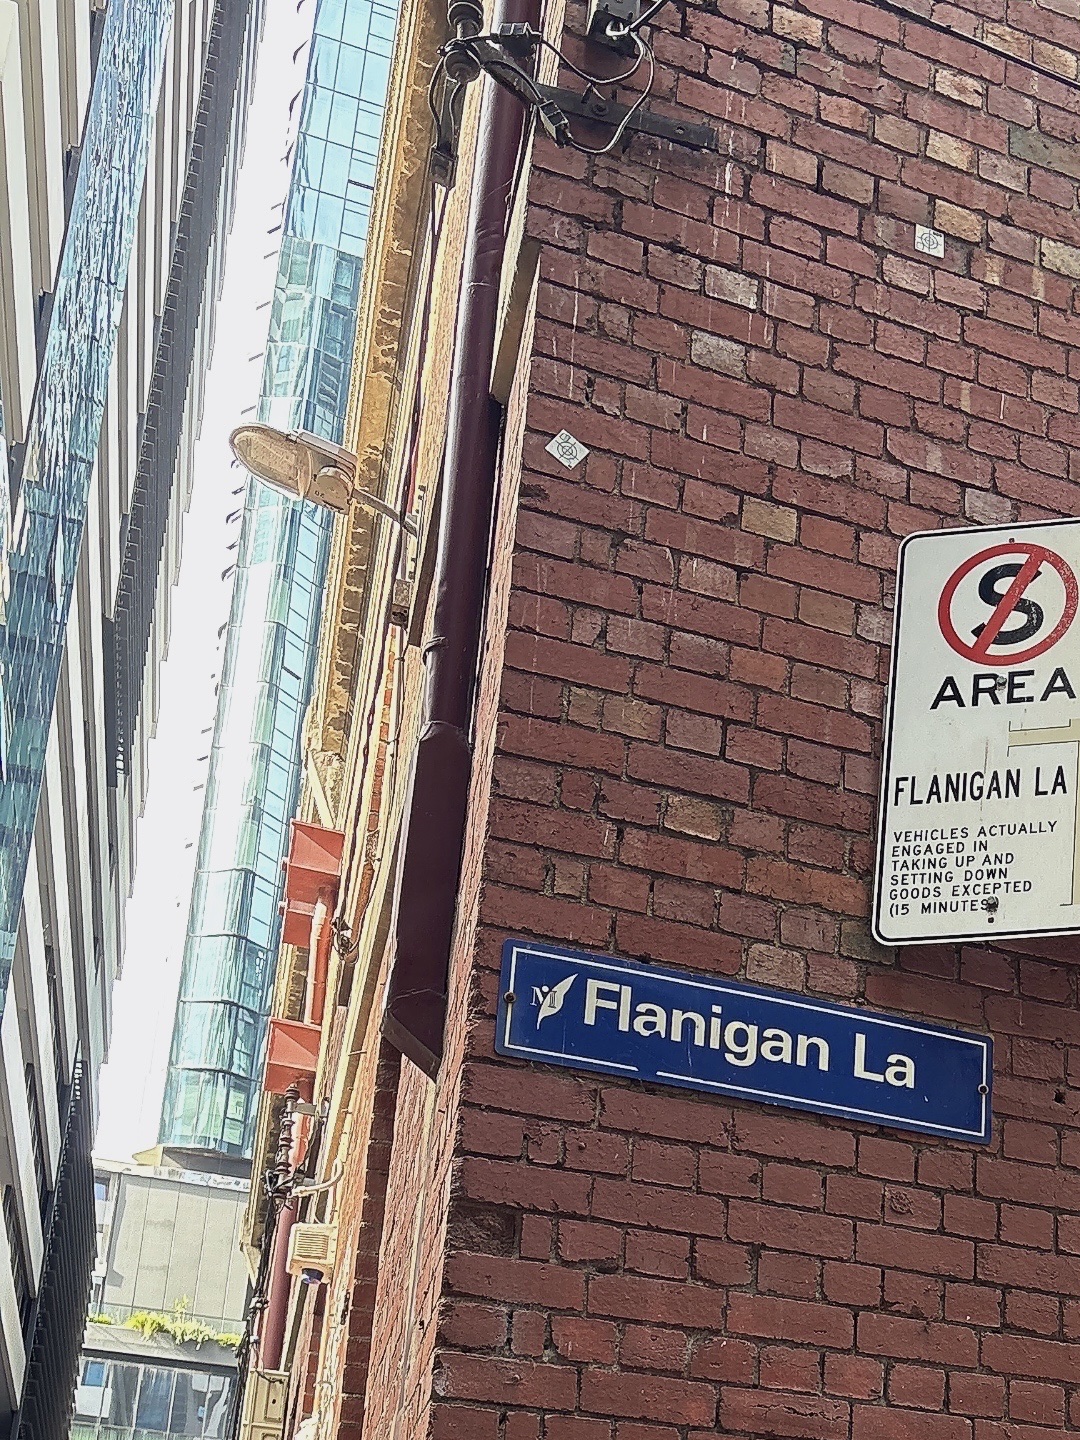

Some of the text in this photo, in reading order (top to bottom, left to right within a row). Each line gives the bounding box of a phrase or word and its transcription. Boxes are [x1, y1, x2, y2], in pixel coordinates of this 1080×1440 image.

[930, 667, 1077, 710] AREA
[894, 765, 1067, 806] FLANIGAN LA
[893, 820, 1058, 843] VEHICLES ACTUALLY
[892, 840, 988, 857] ENGAGED IN
[892, 852, 1014, 872] TAKING UP AND
[890, 867, 1008, 886] SETTING DOWN
[889, 880, 1032, 900] GOODS EXCEPTED
[889, 902, 910, 917] (15
[583, 978, 831, 1071] Flanigan
[853, 1032, 916, 1089] La
